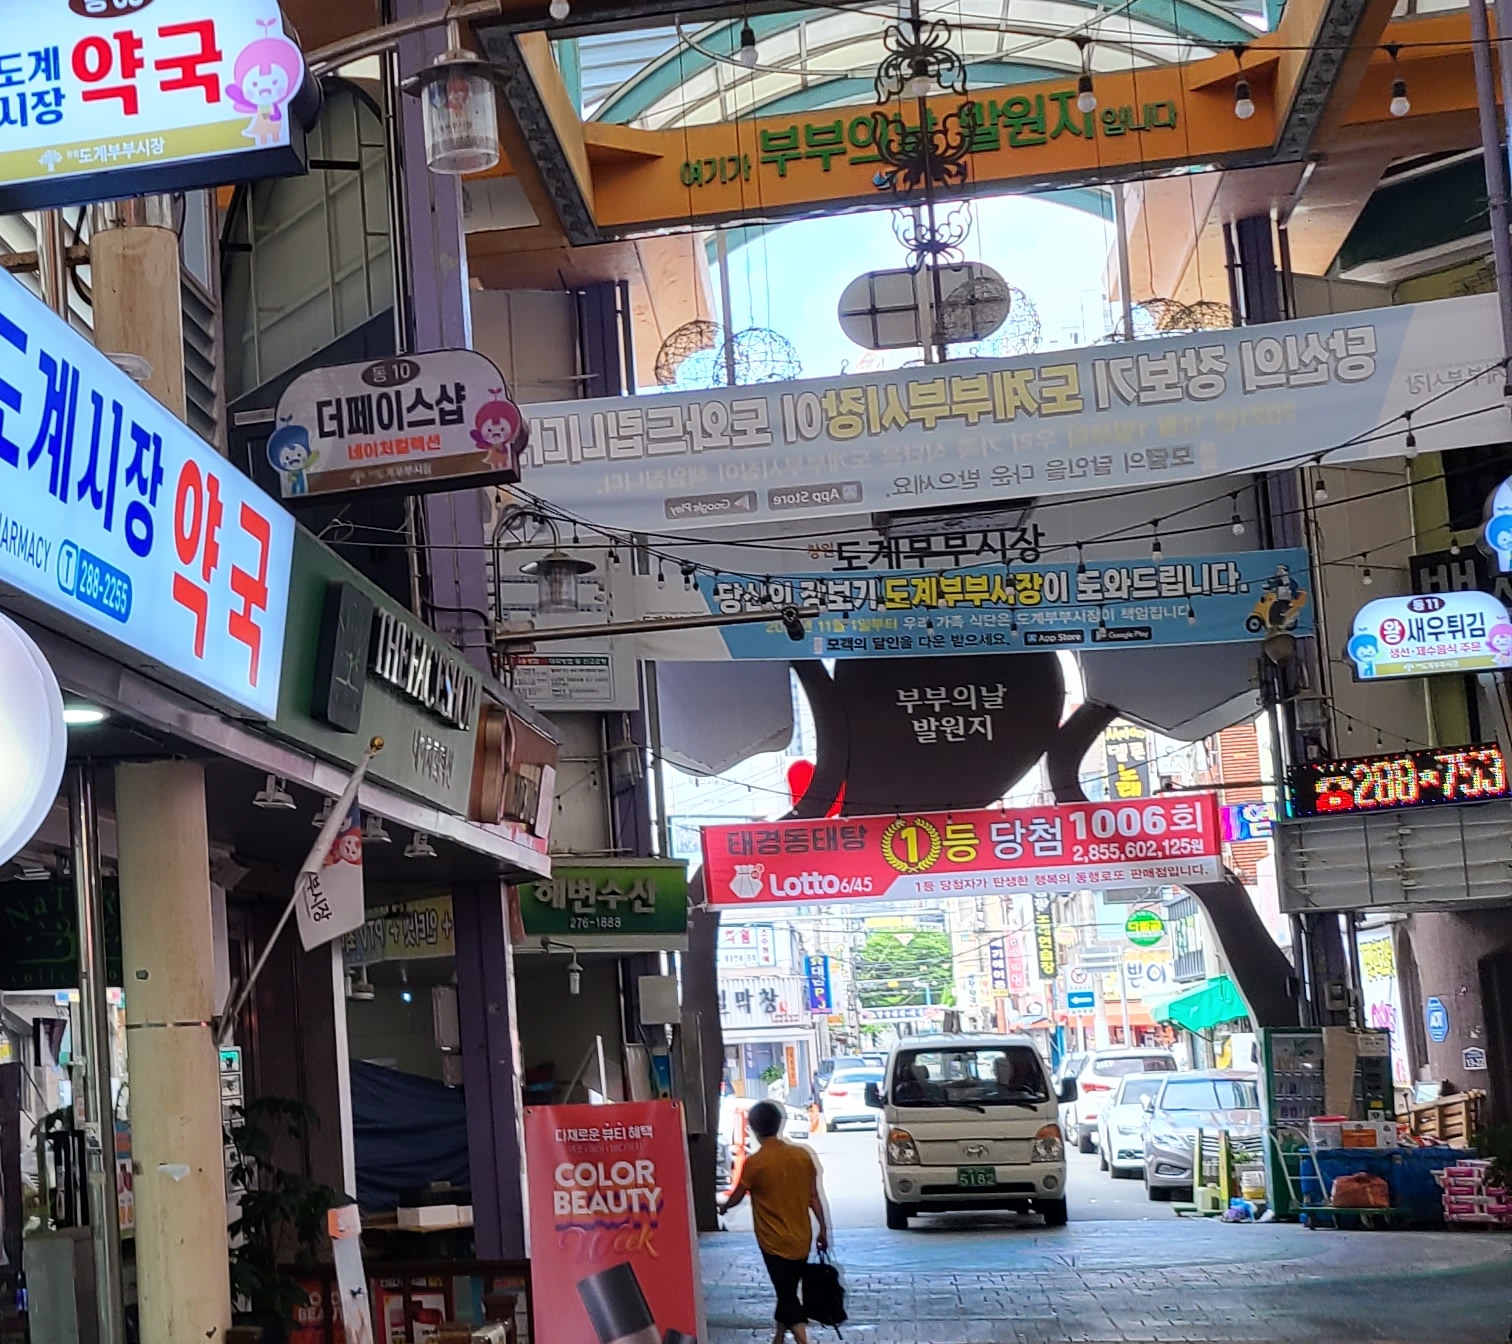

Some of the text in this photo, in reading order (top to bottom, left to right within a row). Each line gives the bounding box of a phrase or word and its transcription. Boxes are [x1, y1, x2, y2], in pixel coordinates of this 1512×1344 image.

[71, 19, 223, 116] 약국
[78, 138, 165, 163] 도계부부시장
[680, 153, 751, 188] 여기가
[1101, 100, 1177, 137] 입니다
[372, 363, 411, 383] 동 10
[316, 382, 466, 439] 더페이스샵
[347, 434, 441, 461] 네이처컬렉션
[832, 524, 1047, 571] 도계부부시장
[79, 557, 128, 615] 288-2255
[172, 458, 271, 688] 약국
[717, 561, 1250, 614] 당신의 장보기 도계부부시장이 도와드립니다.
[937, 614, 966, 630] 가족
[970, 613, 1012, 629] 식단은
[1381, 611, 1486, 644] 왕 새우튀김
[872, 635, 913, 651] 달인을
[896, 683, 1008, 713] 부부의날
[911, 713, 995, 745] 발원지
[1069, 801, 1204, 841] 1006회
[727, 824, 868, 857] 태경동태탕
[990, 816, 1064, 859] 당첨
[1072, 837, 1205, 864] 2,855,602,125원
[915, 880, 935, 893] 1등
[939, 876, 988, 891] 당첨자가
[992, 874, 1029, 889] 탄생한
[1034, 872, 1071, 886] 행복의
[1075, 869, 1126, 884] 동행로또
[569, 917, 622, 929] 276-1888
[555, 1127, 601, 1143] 다채로운
[602, 1124, 627, 1142] 뷰티
[554, 1159, 655, 1188] COLOR
[959, 1172, 996, 1186] 5182
[553, 1186, 662, 1216] BEAUTY
